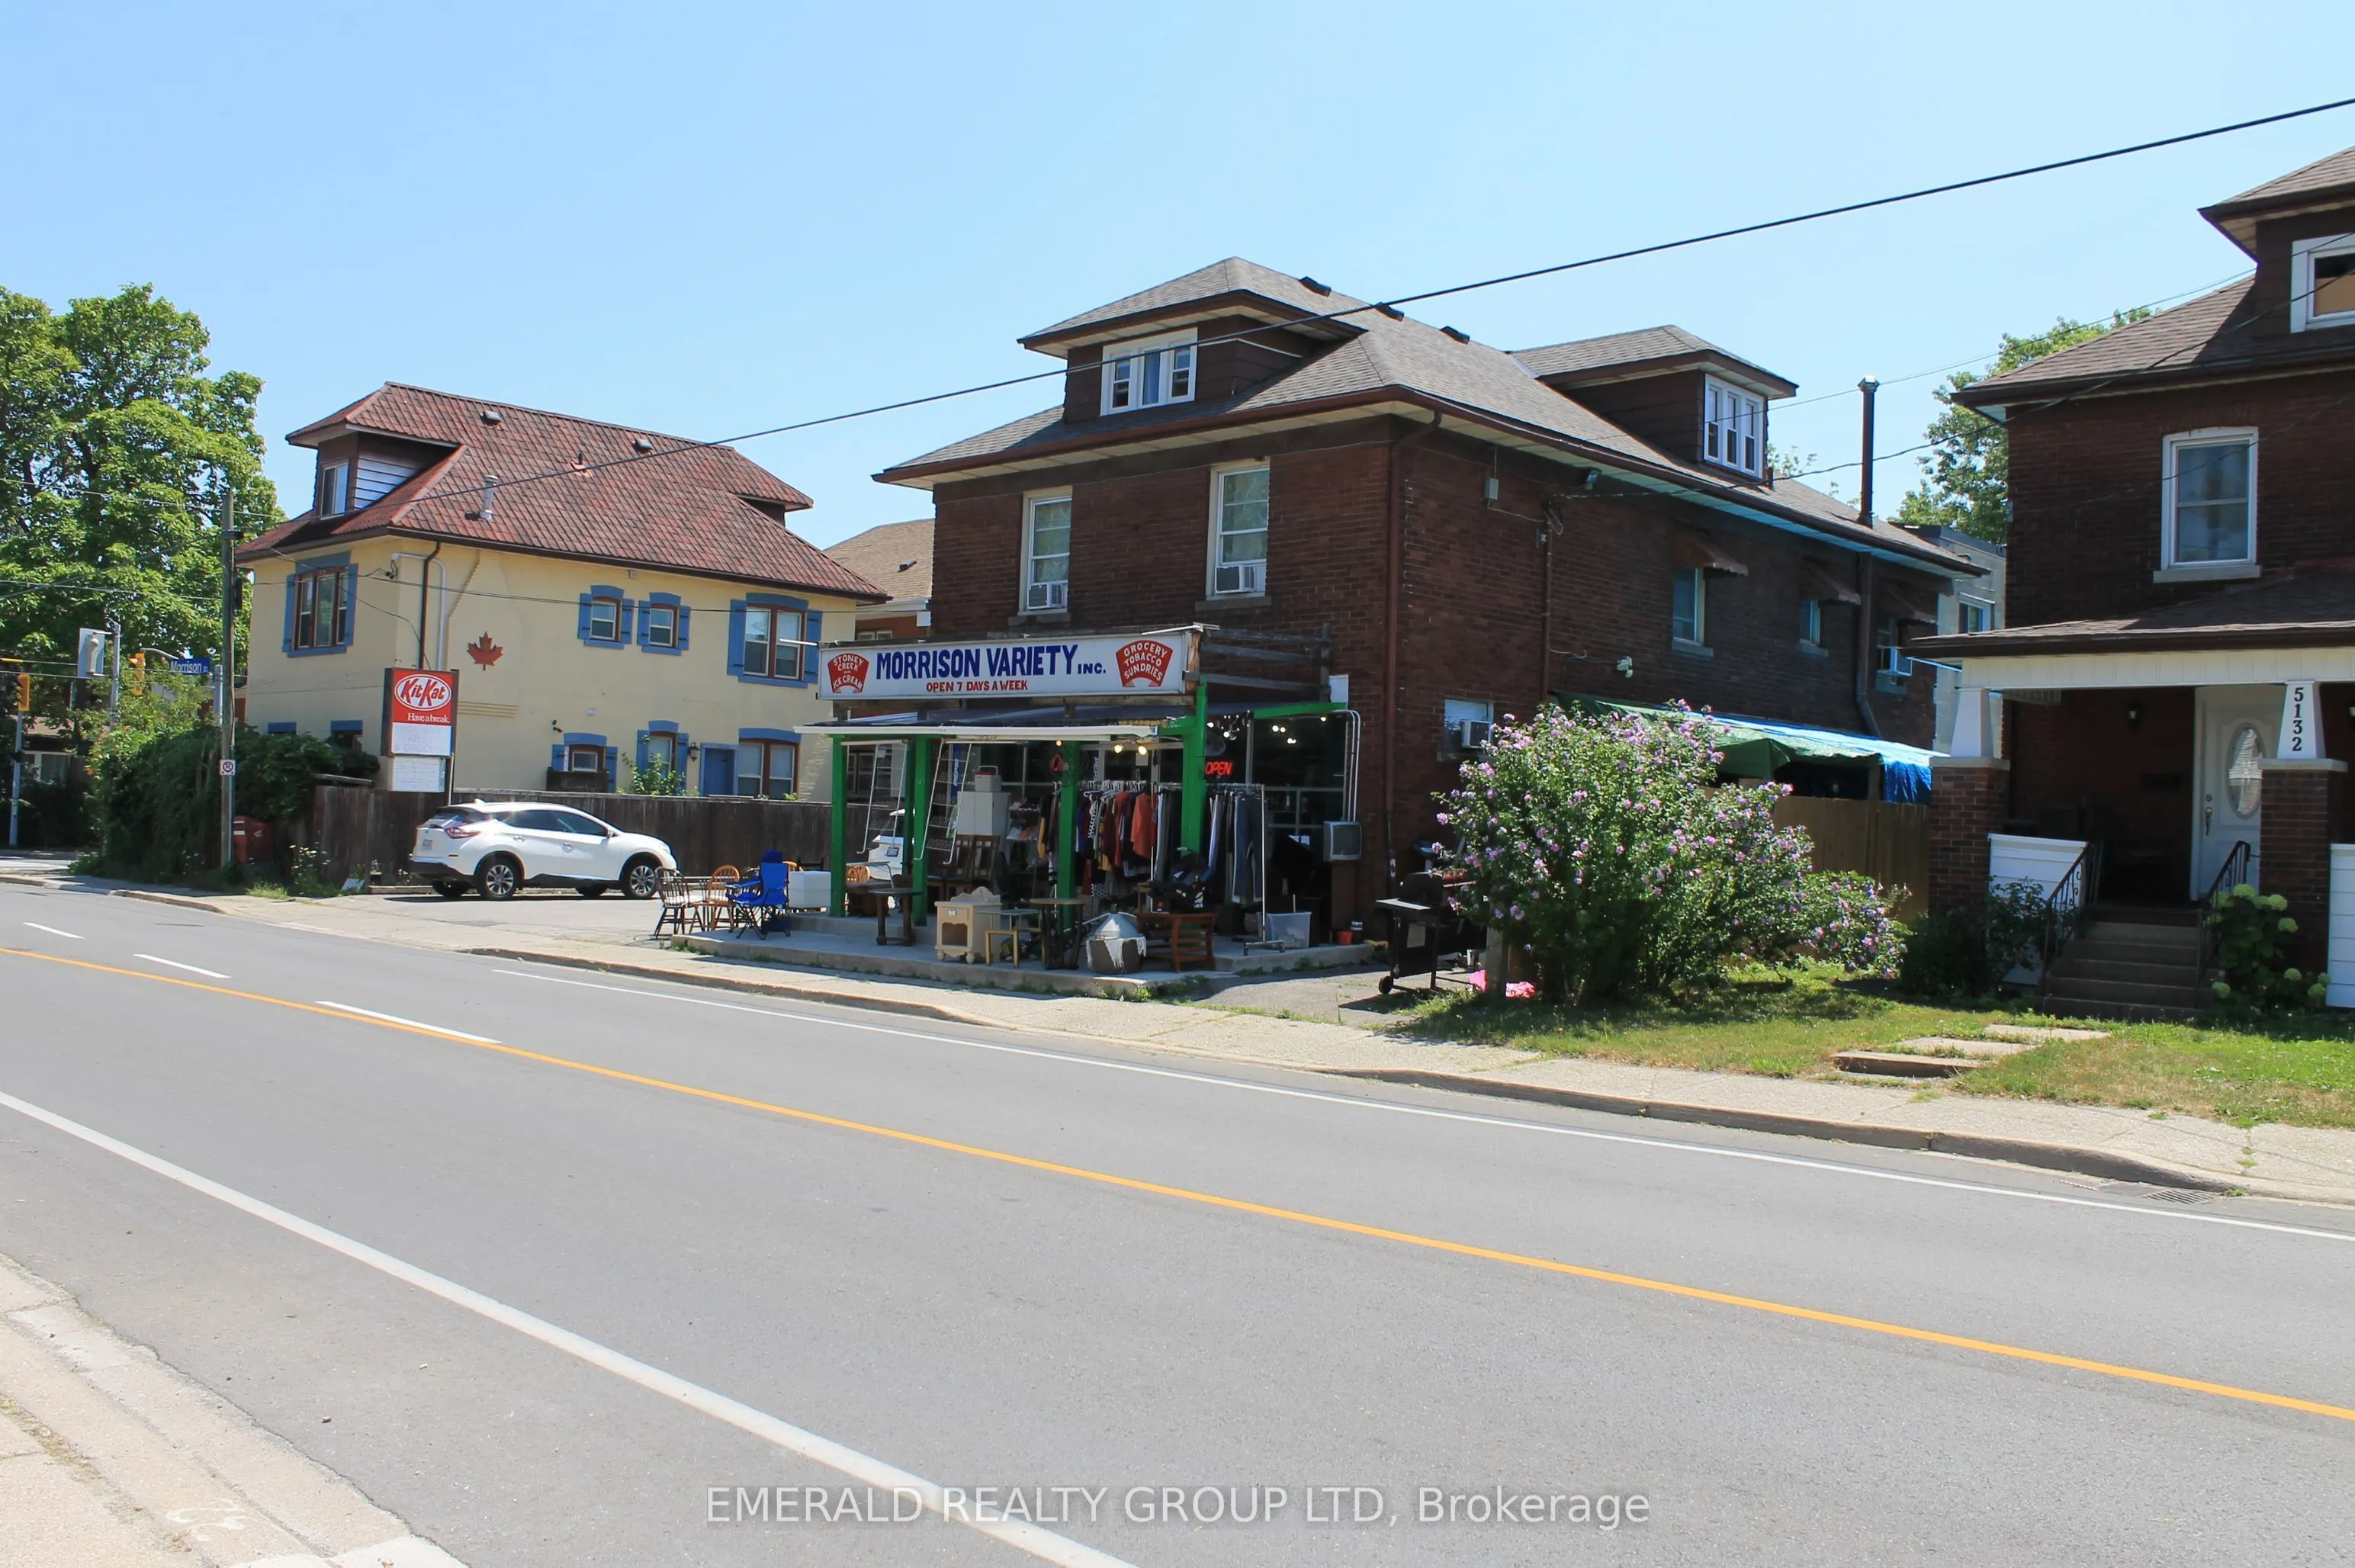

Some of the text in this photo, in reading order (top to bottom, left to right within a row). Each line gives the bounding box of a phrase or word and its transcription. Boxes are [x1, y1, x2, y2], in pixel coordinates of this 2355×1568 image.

[1123, 642, 1168, 658] GROCERY
[170, 660, 202, 673] Morrison
[833, 654, 864, 667] STONEY
[837, 662, 859, 672] CREEK
[876, 644, 1106, 680] MORRISON VARIETY INC.
[1124, 652, 1162, 667] TOBACCO
[1123, 663, 1163, 682] SUNDRIES
[833, 674, 863, 690] ICE CREAM
[926, 680, 1028, 692] OPEN 7 DAYS A WEEK
[407, 712, 425, 722] Have
[2292, 687, 2304, 752] 5132
[1205, 761, 1232, 776] OPEN
